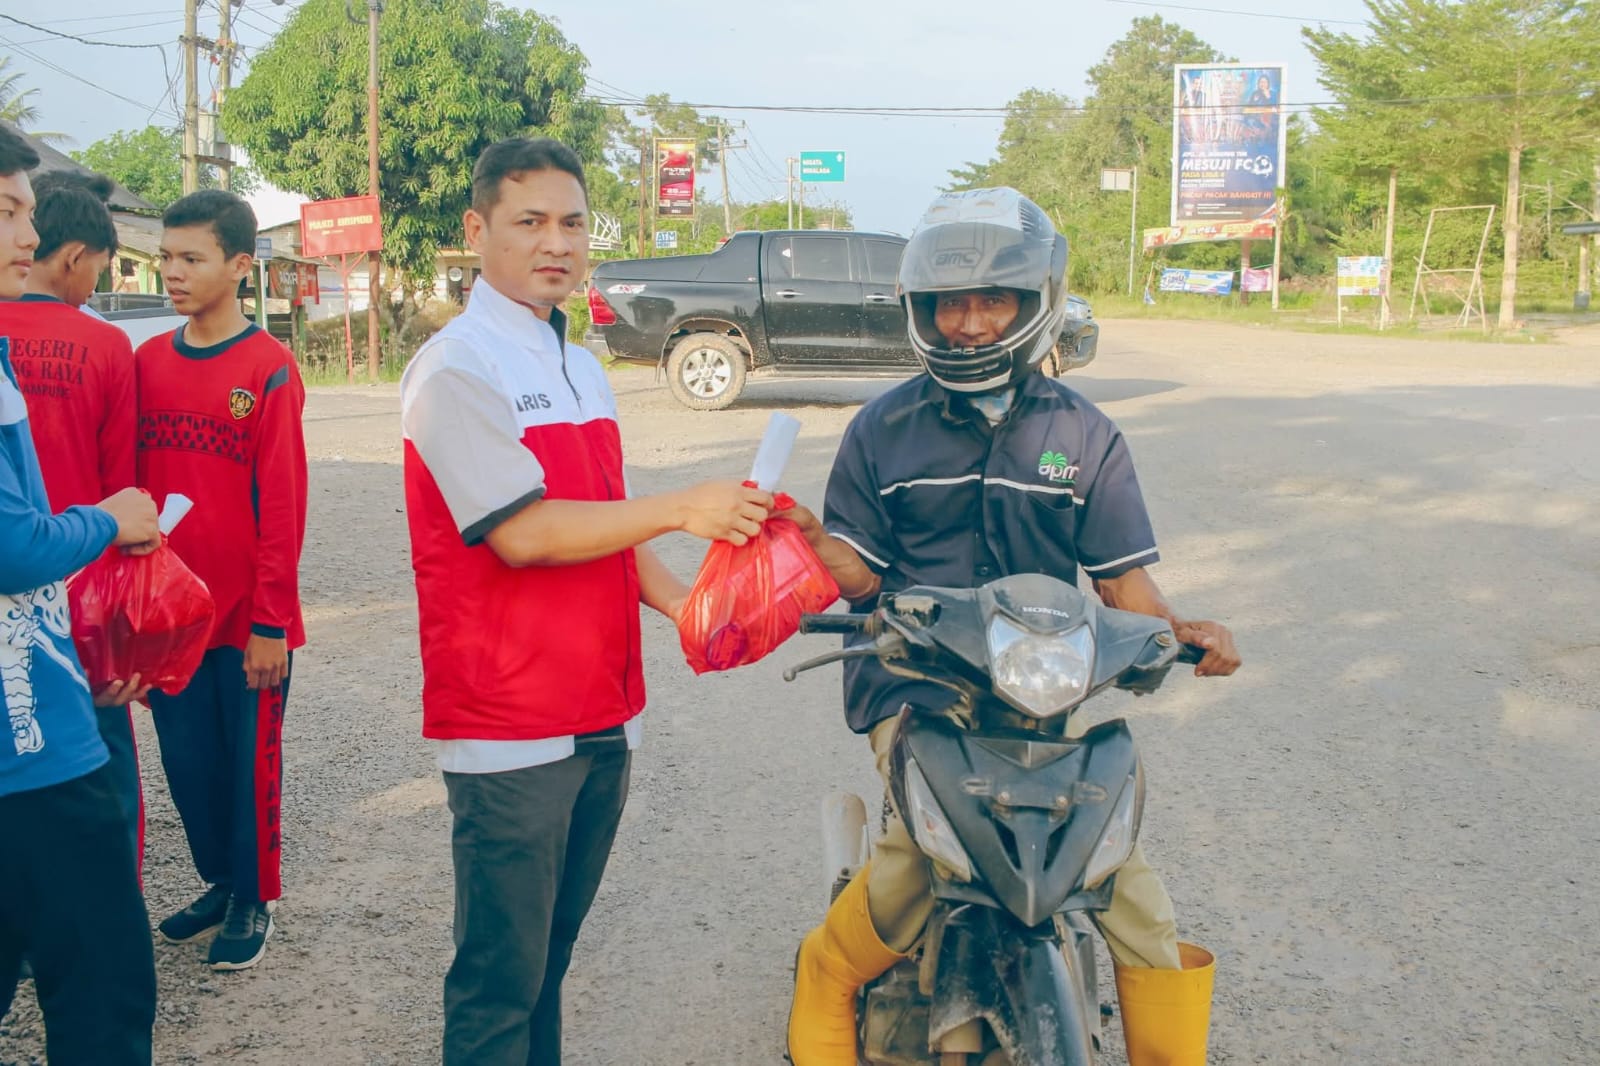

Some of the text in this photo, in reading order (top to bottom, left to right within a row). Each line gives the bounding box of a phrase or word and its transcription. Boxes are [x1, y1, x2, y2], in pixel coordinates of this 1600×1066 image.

[1181, 159, 1253, 170] MESUJI FC
[657, 232, 676, 241] ATM
[41, 361, 84, 385] RAYA
[1023, 606, 1070, 618] HONDA
